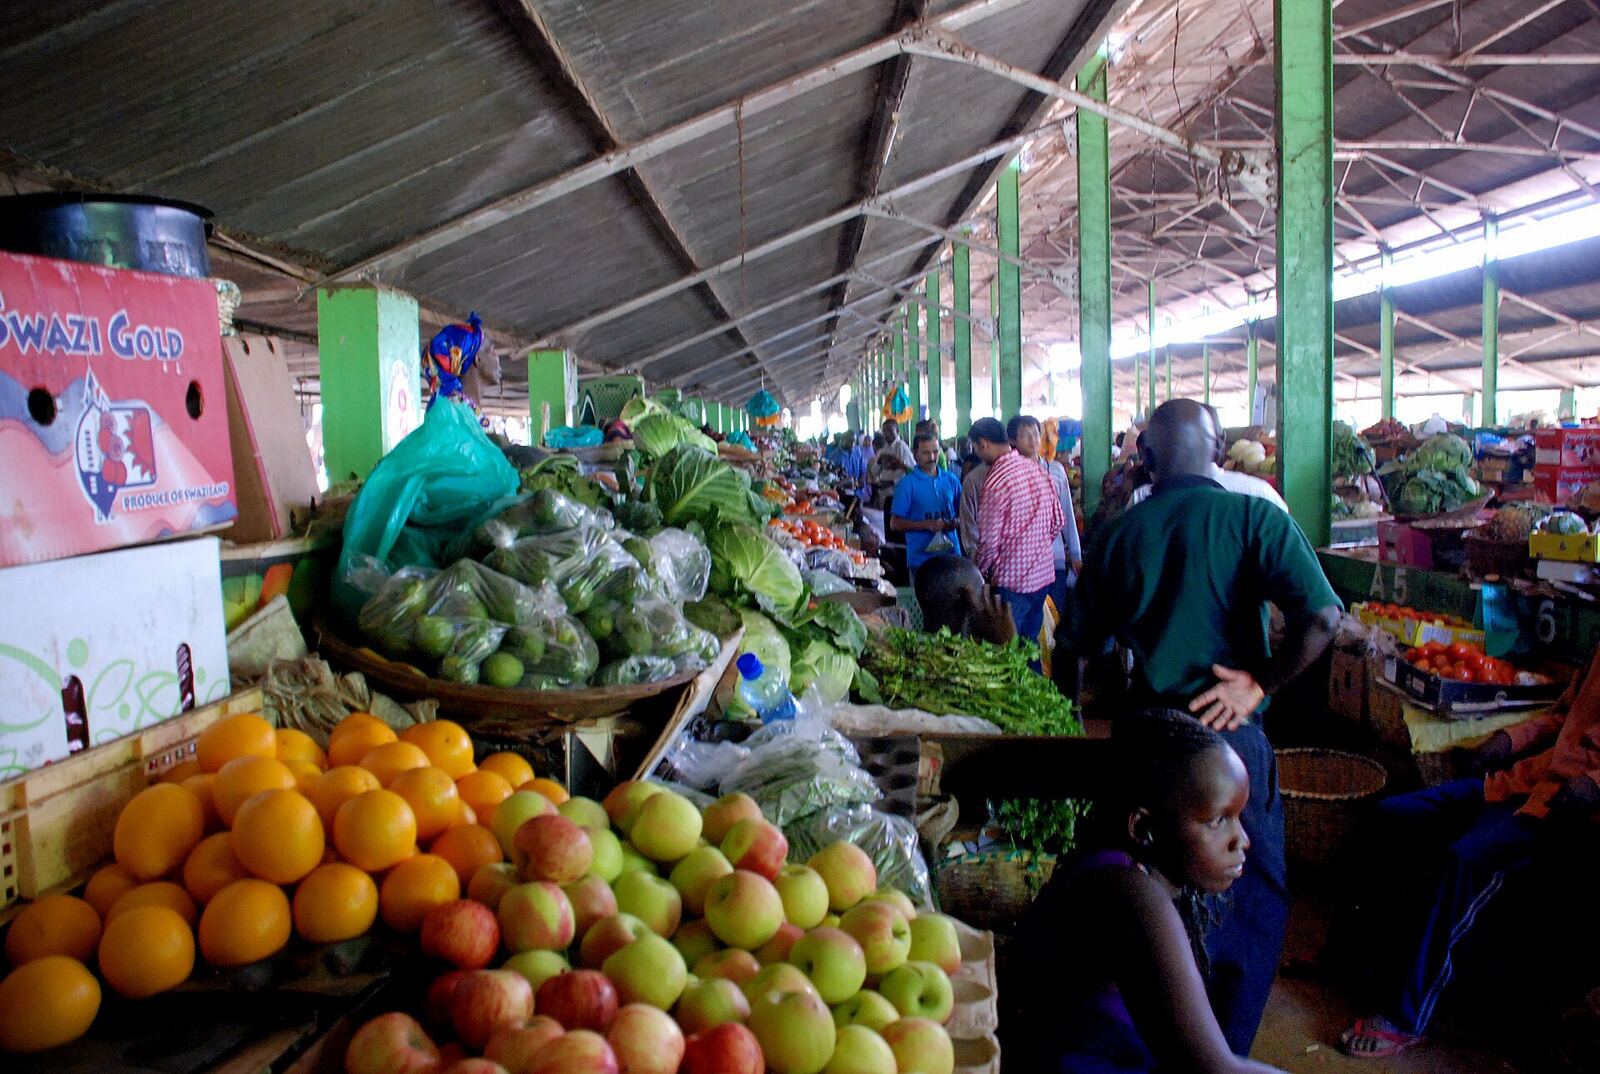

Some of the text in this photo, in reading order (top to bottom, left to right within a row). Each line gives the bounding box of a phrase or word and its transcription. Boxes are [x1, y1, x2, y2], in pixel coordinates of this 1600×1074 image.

[122, 482, 230, 511] PRODUCE OF SWAZILAND
